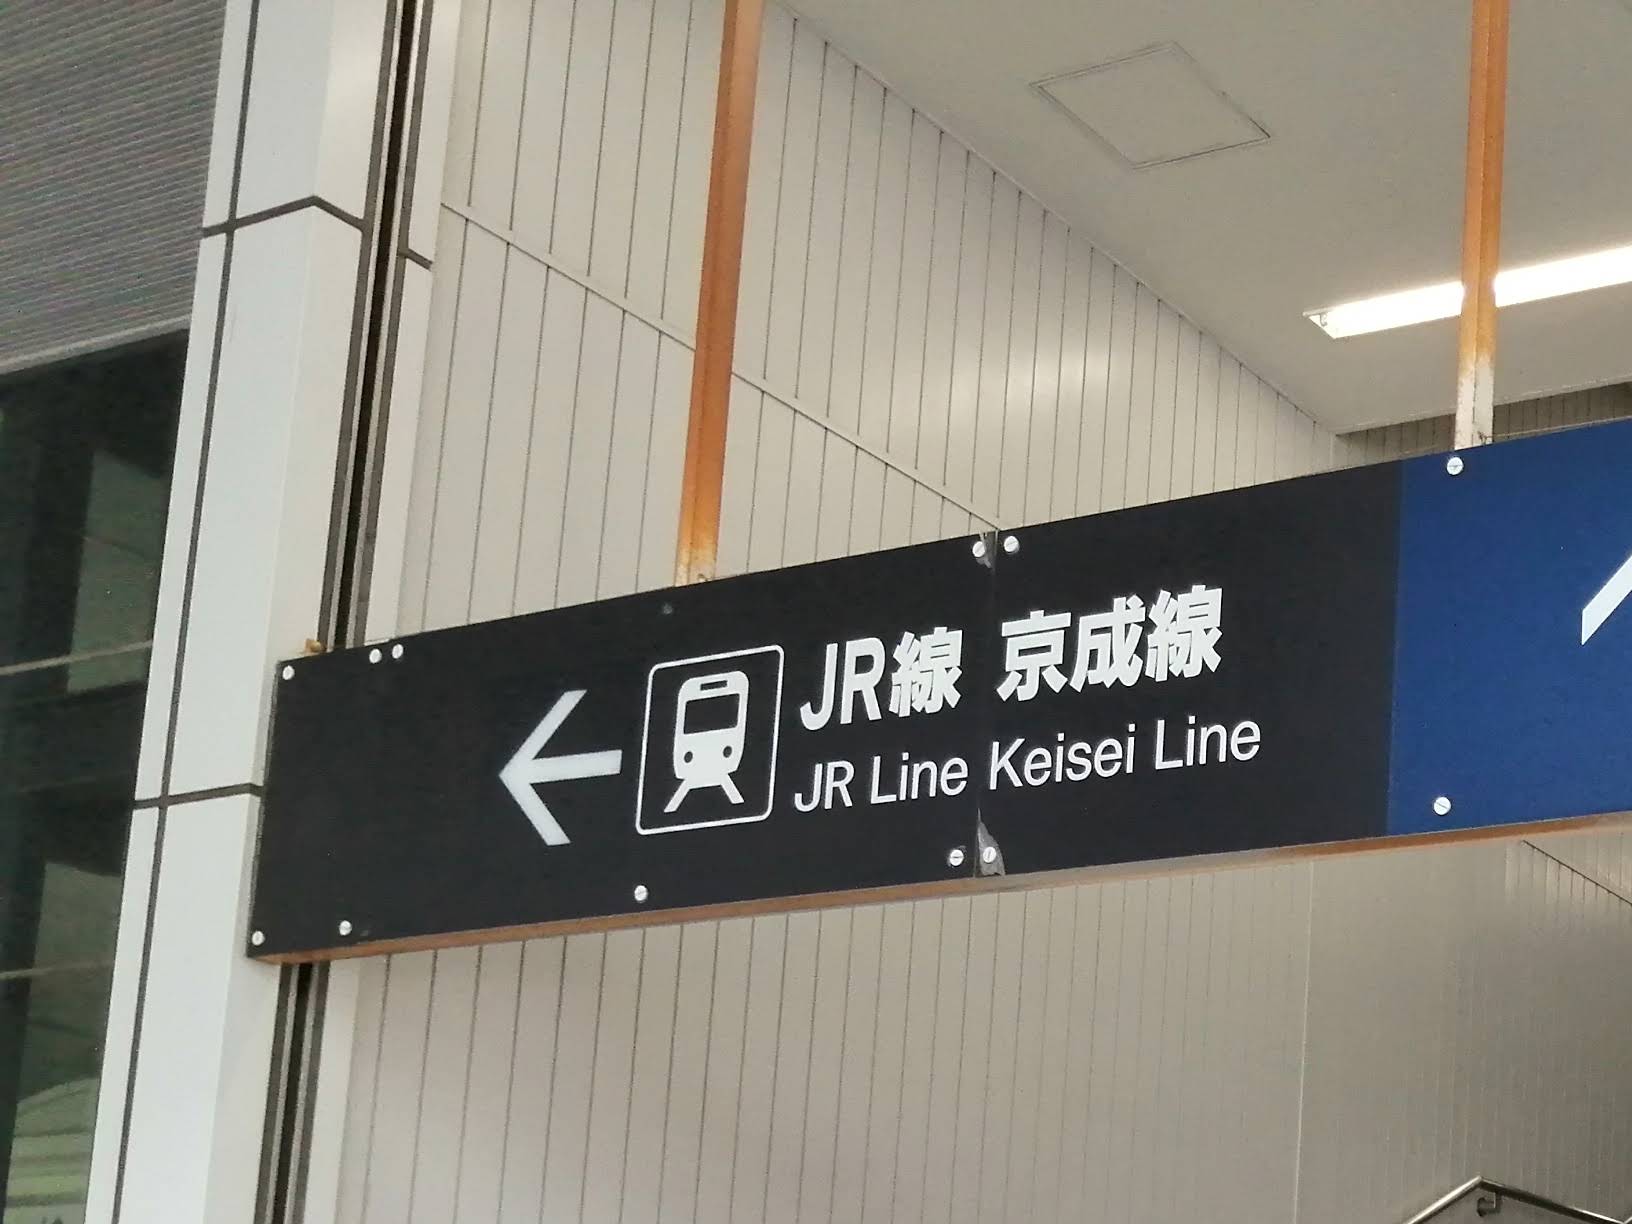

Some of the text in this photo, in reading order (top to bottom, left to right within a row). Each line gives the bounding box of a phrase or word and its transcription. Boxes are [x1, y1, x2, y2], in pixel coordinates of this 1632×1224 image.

[799, 584, 1223, 731] JR線 京成線
[794, 715, 1261, 812] JR Line Keisei Line
